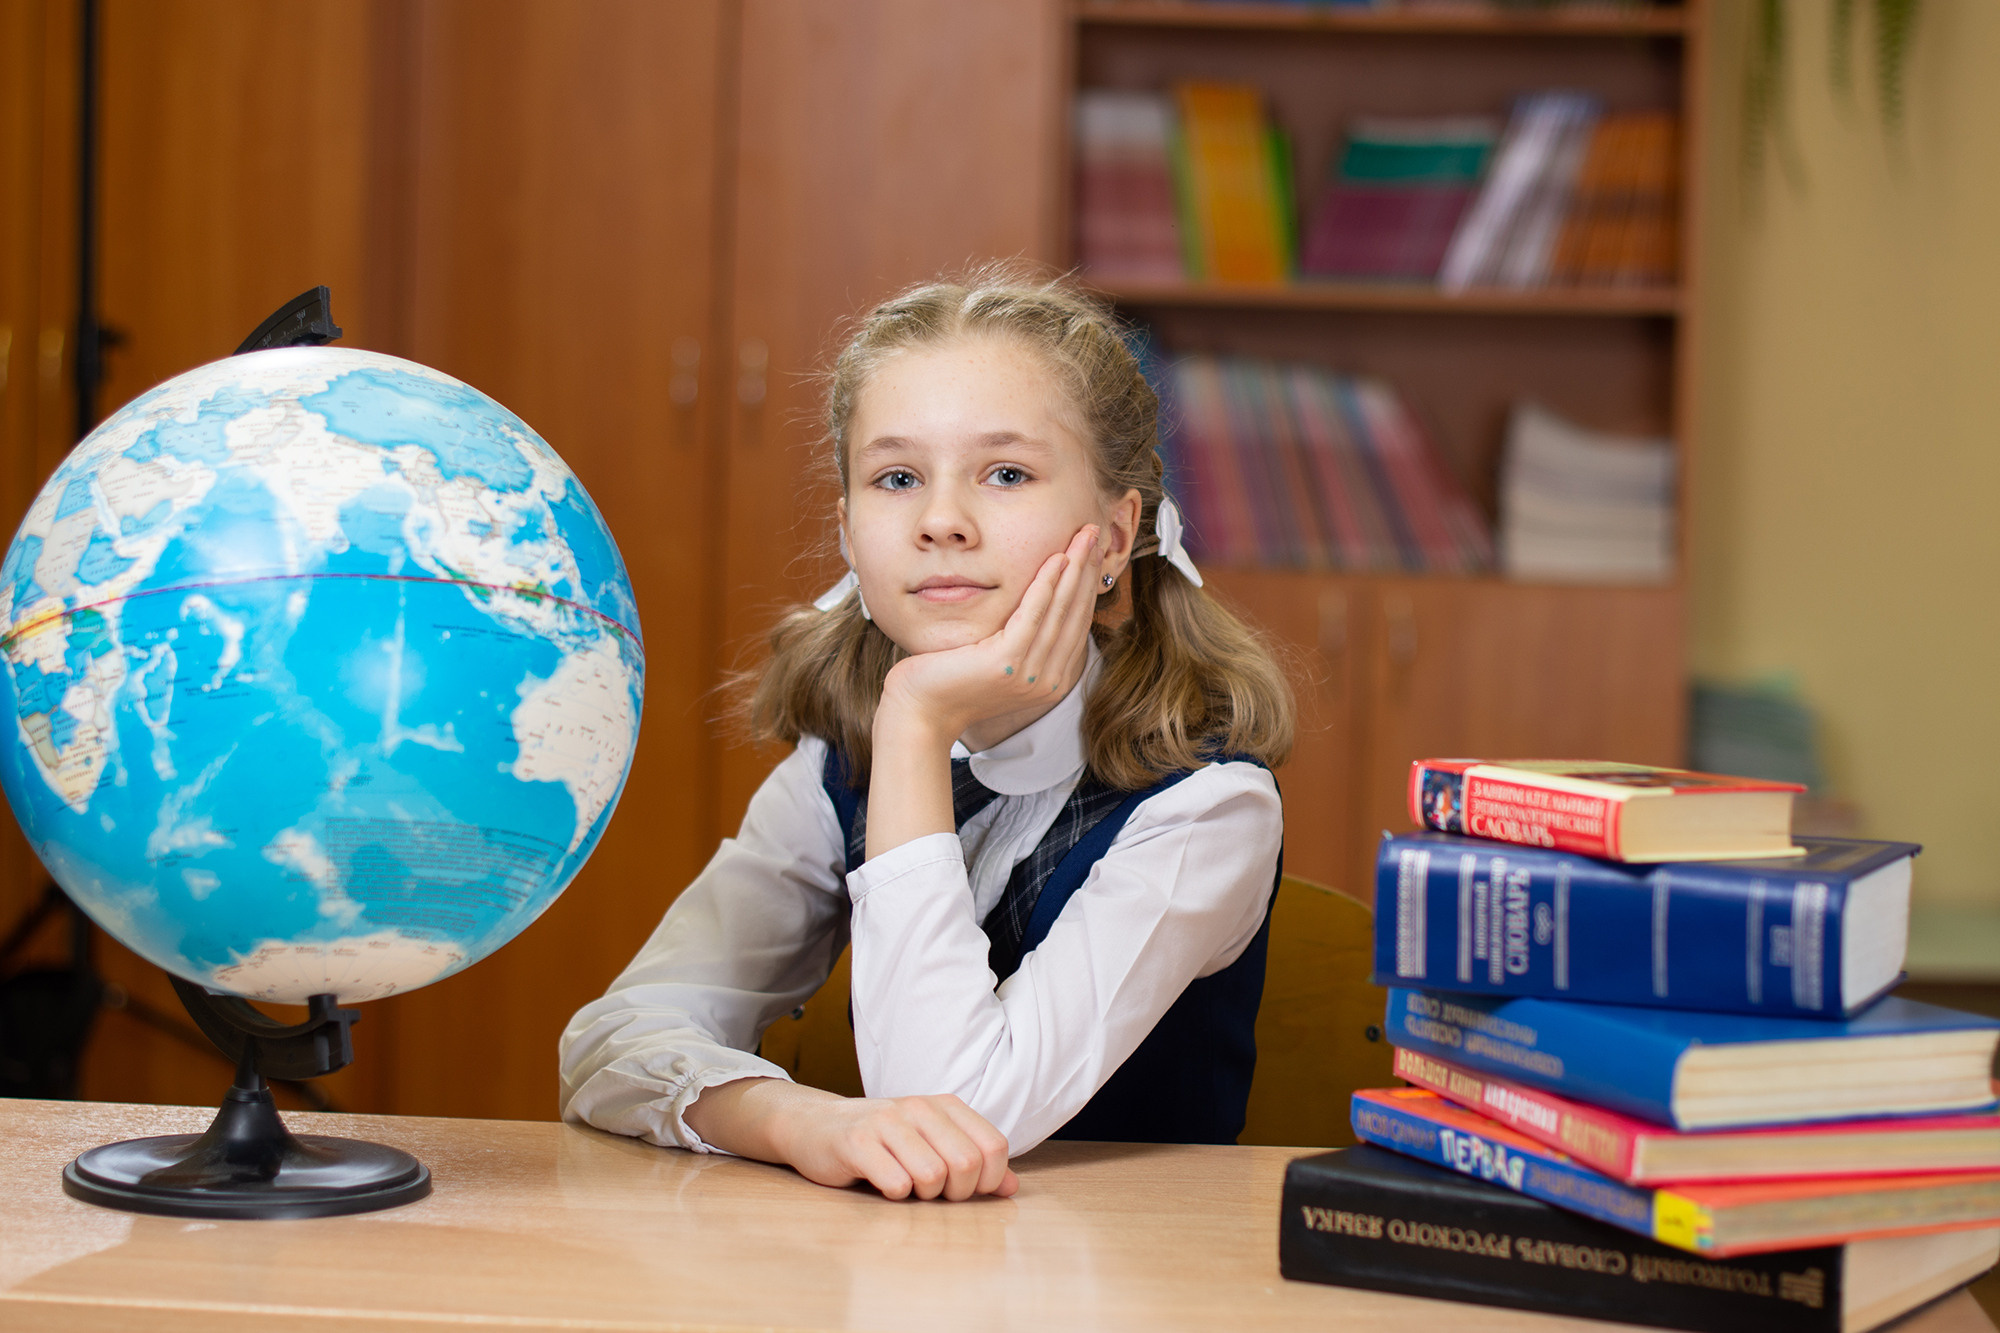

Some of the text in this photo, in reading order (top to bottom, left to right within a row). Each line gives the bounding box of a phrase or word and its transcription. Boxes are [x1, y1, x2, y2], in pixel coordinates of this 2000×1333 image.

[1470, 813, 1556, 848] СЛОВАРЬ
[1505, 867, 1530, 975] СЛОВАРЬ
[1439, 1128, 1526, 1192] ПЕРВАЯ
[1301, 1205, 1385, 1240] ЯЗЫКА
[1387, 1218, 1512, 1260] РУССКОГО
[1514, 1236, 1628, 1276] СЛОВАРЬ
